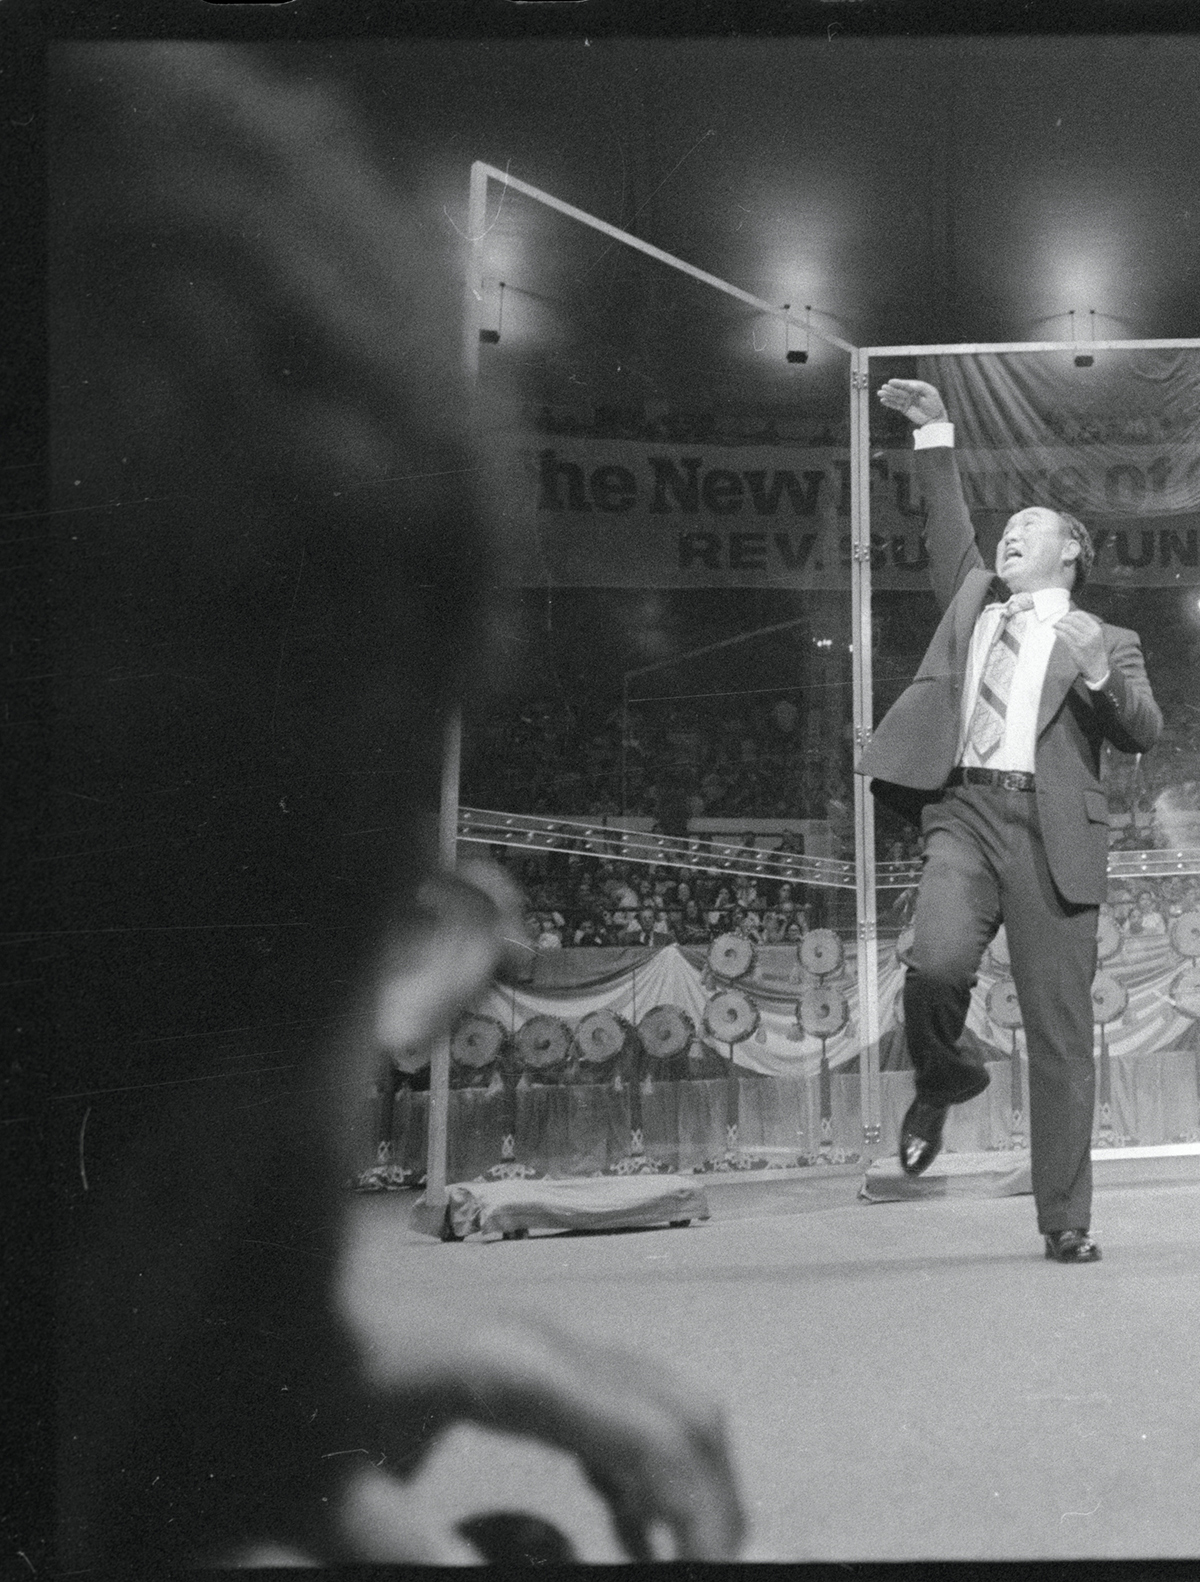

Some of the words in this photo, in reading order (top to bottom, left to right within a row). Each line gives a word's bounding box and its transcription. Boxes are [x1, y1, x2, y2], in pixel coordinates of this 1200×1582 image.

[538, 448, 638, 513] he
[648, 457, 825, 516] New
[833, 459, 1090, 516] Fuure
[1104, 456, 1172, 512] of
[678, 532, 824, 570] REV.
[839, 533, 932, 571] SU
